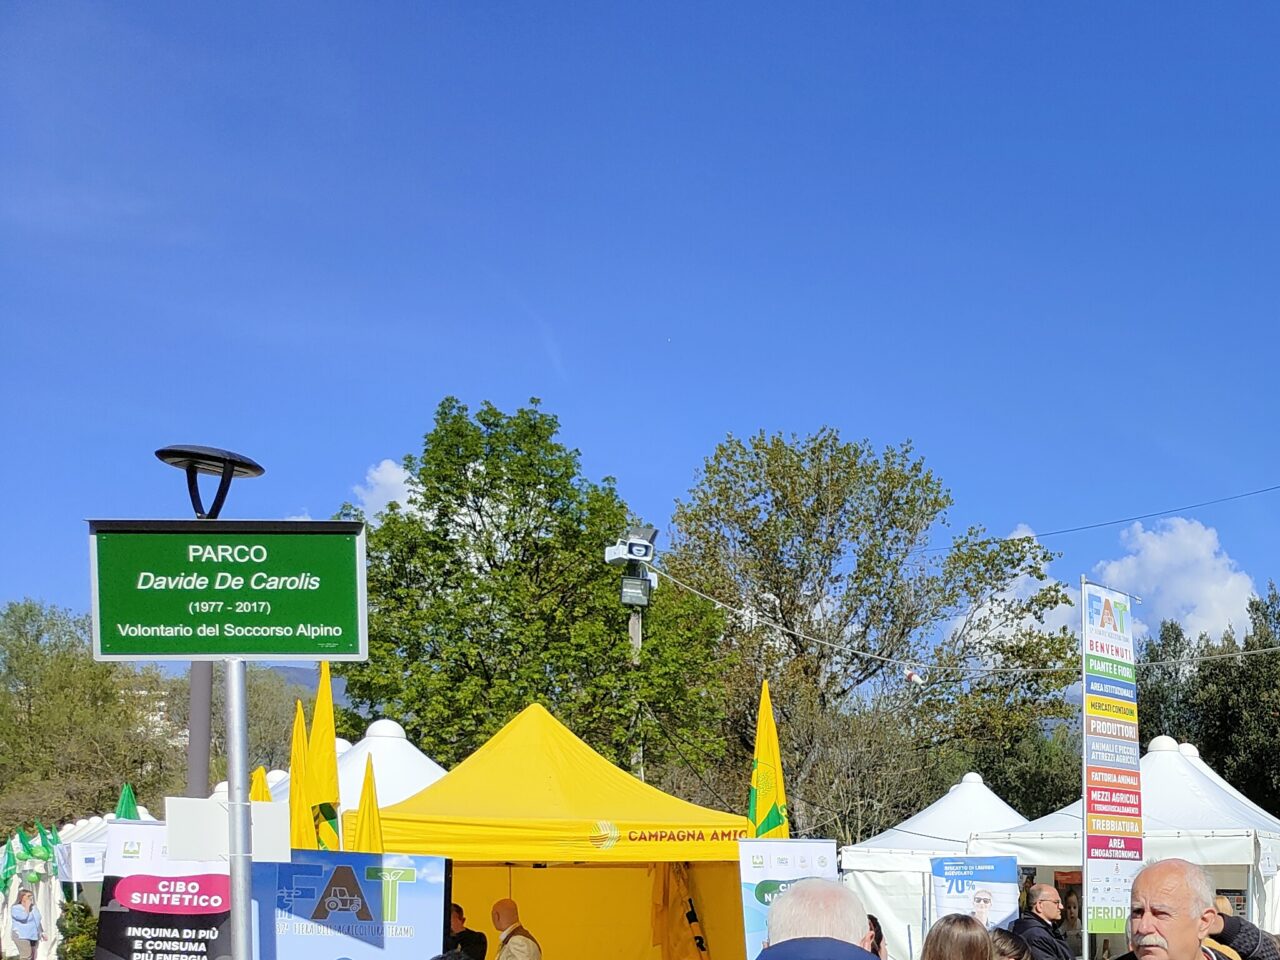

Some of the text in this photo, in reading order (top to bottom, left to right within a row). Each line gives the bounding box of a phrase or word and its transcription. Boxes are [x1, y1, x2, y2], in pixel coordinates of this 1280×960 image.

[187, 545, 268, 563] PARCO
[136, 572, 321, 590] Davide De Carolis
[188, 601, 224, 615] (1977
[235, 601, 271, 615] 2017)
[1087, 593, 1128, 634] FAT
[117, 623, 343, 640] Volontario del Soccorso Alpino
[1089, 639, 1132, 661] BENVENUTI
[1089, 659, 1113, 674] PIANTE
[1113, 664, 1117, 675] E
[1090, 681, 1104, 692] AREA
[1090, 701, 1112, 712] MERCATI
[1090, 720, 1136, 739] PRODUTTORI
[1091, 741, 1114, 752] ANIMALI
[1091, 771, 1117, 782] FATTORIA
[1091, 790, 1139, 804] MEZZI AGRICOLI
[1092, 819, 1139, 833] TREBBIATURA
[628, 829, 706, 843] CAMPAGNA
[1108, 838, 1125, 849] AREA
[158, 880, 200, 894] CIBO
[275, 863, 416, 923] FAT
[130, 892, 223, 907] SINTETICO
[126, 926, 219, 940] INQUINA DI PIÙ
[293, 924, 314, 936] FIERA
[387, 925, 414, 937] TERAMO
[133, 940, 207, 952] E CONSUMA
